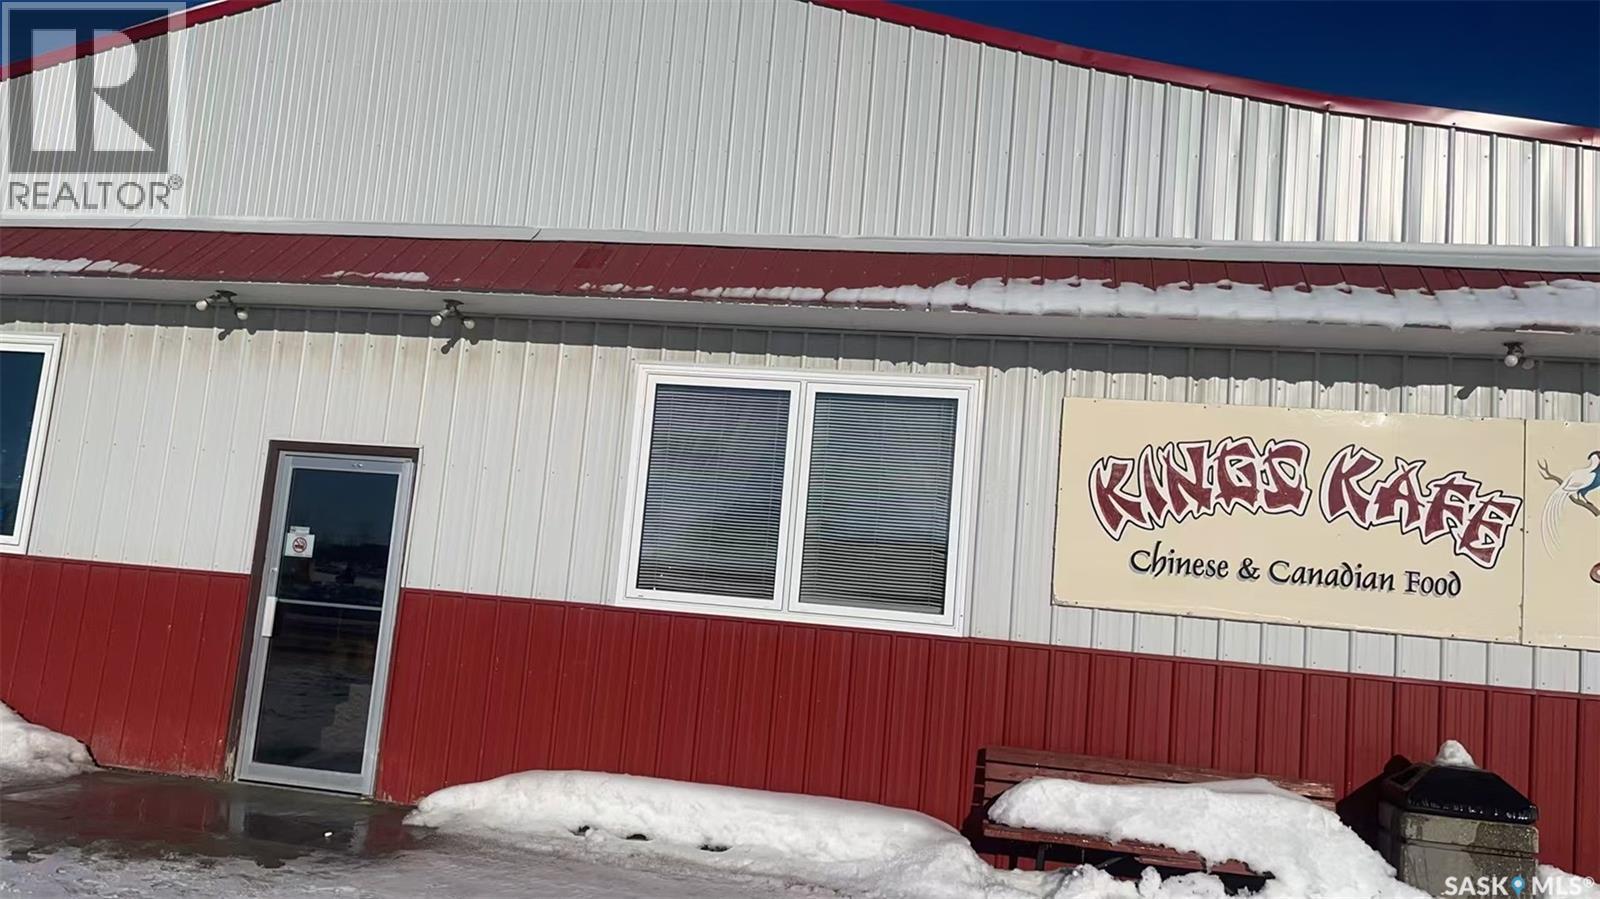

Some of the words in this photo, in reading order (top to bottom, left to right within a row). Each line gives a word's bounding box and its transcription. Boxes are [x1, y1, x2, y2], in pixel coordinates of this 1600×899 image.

[1089, 436, 1311, 541] KINGS
[1319, 444, 1523, 569] KAFE
[1130, 541, 1229, 579] Chinese
[1238, 557, 1261, 580] &
[1269, 560, 1395, 592] Canadian
[1405, 570, 1463, 597] Food
